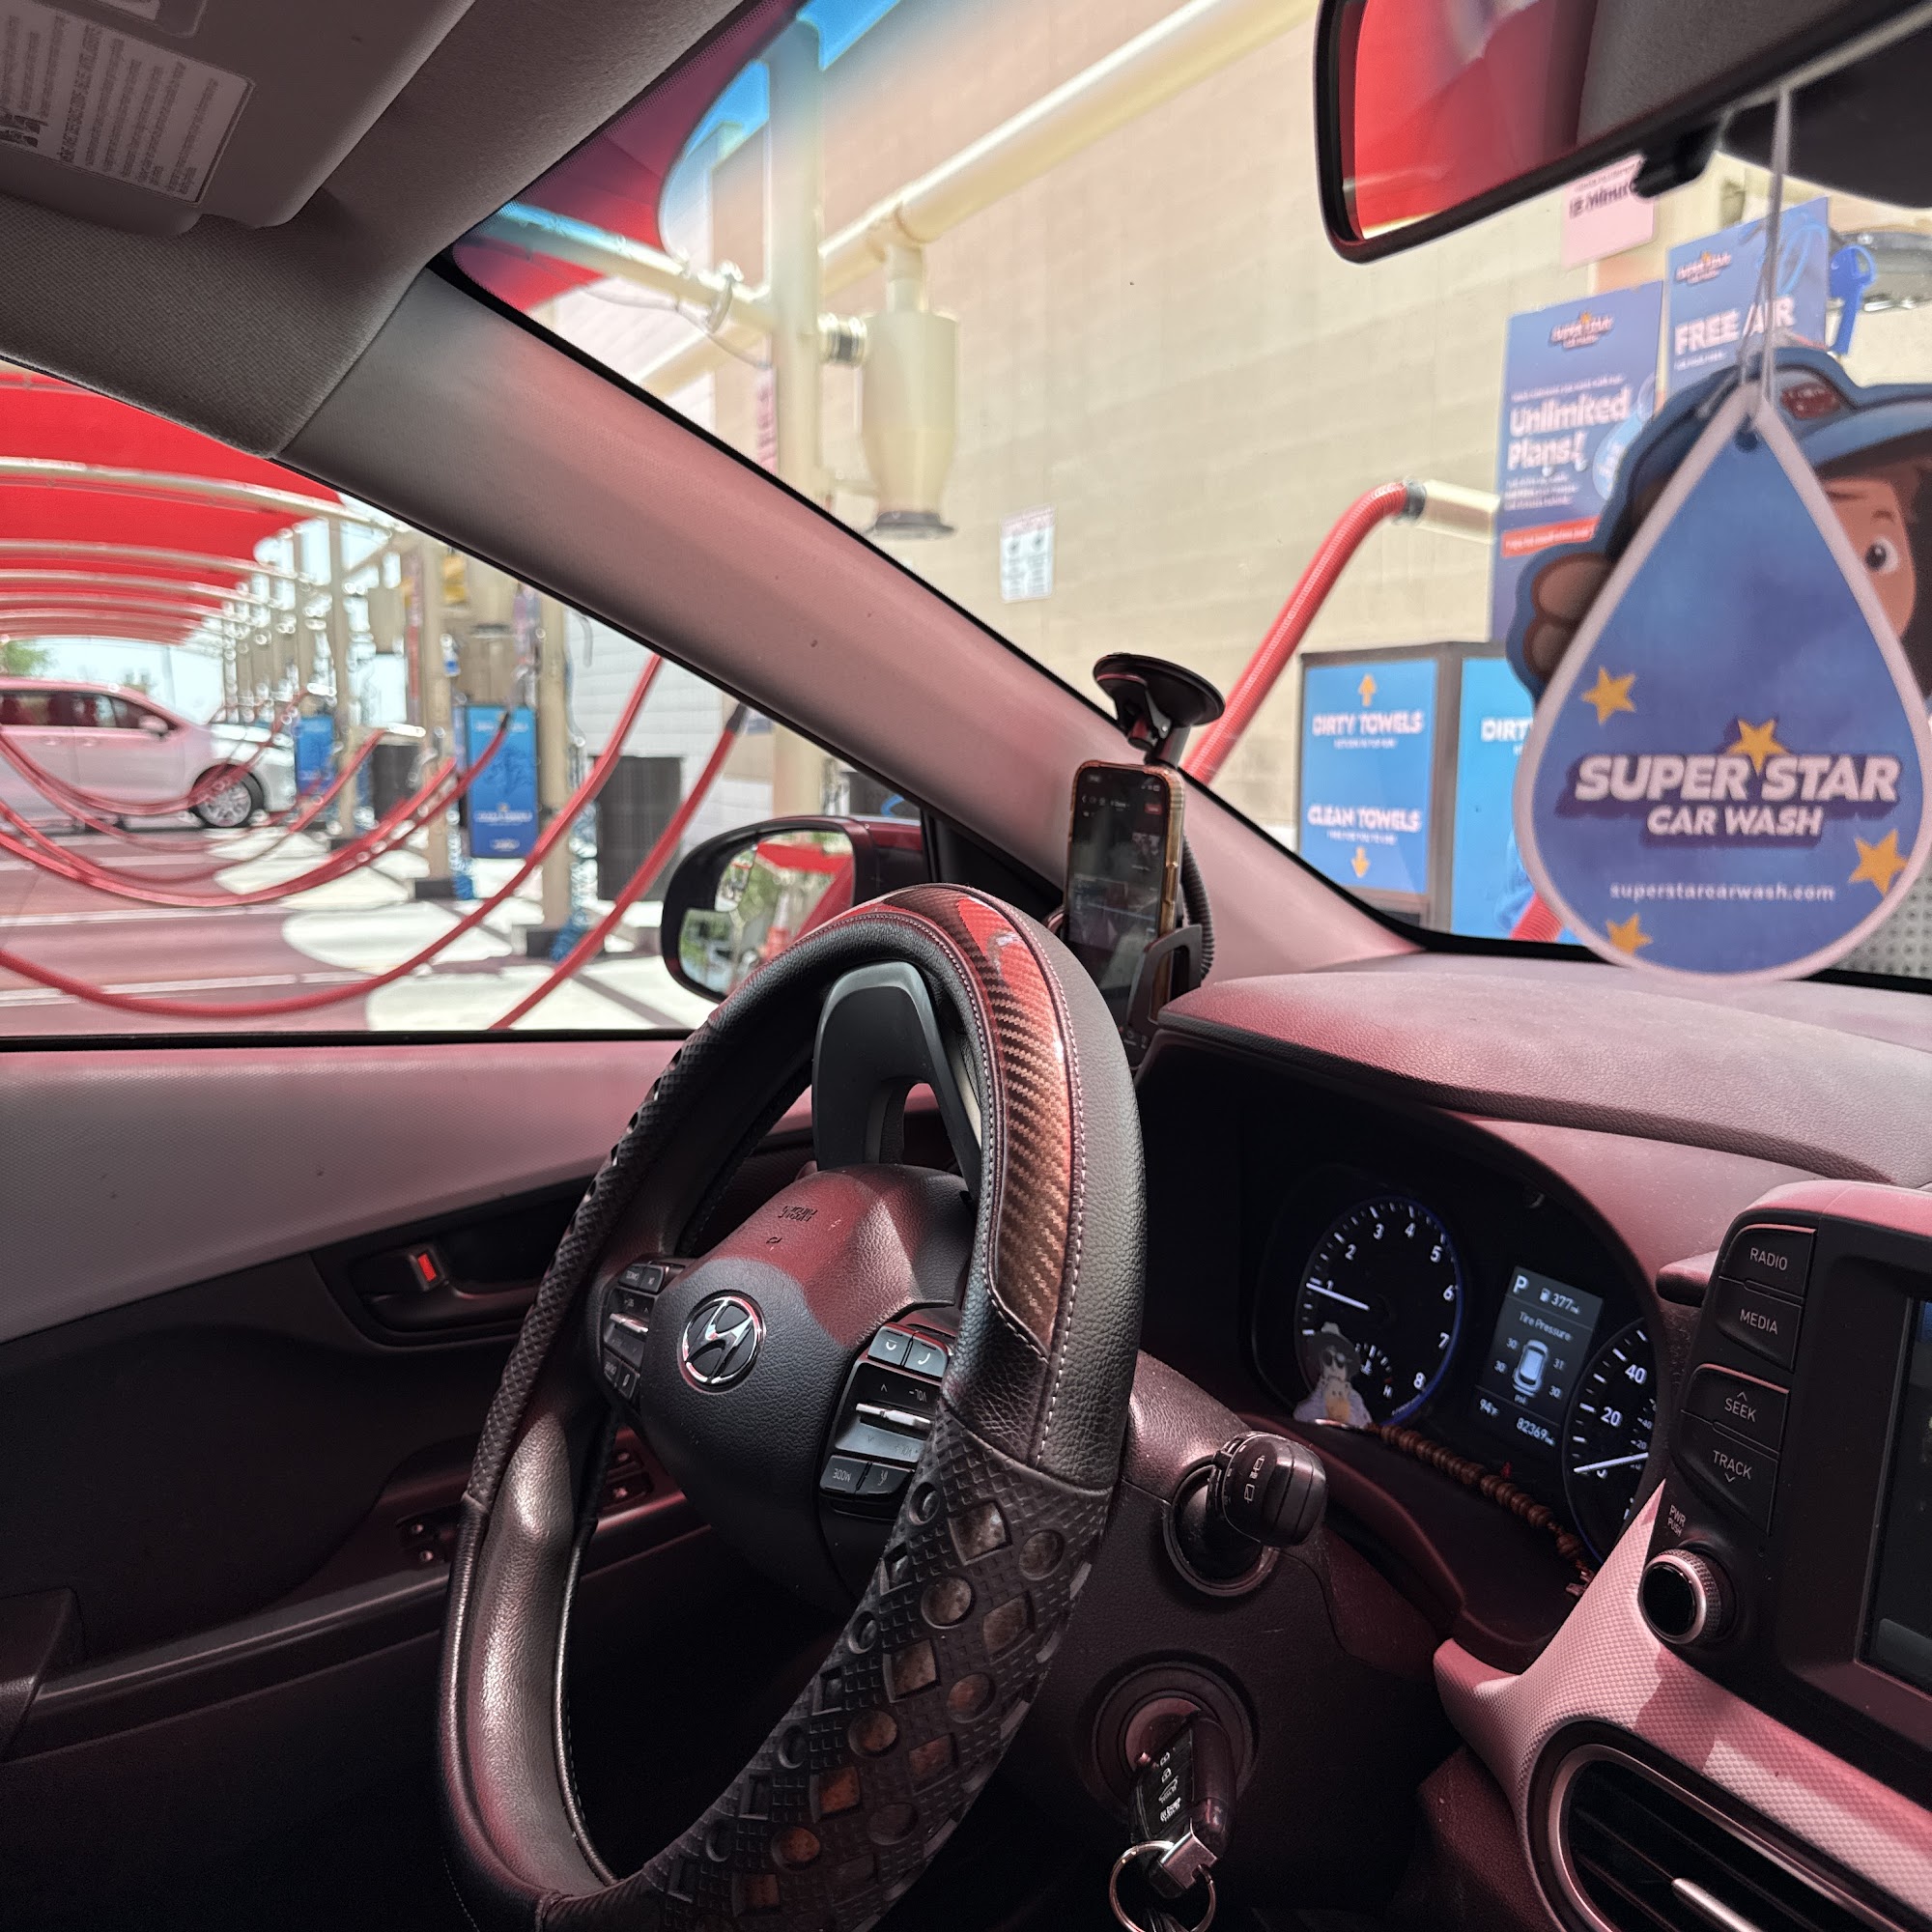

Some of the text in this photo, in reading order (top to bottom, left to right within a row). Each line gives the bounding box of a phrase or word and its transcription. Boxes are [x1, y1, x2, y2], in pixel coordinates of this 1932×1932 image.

[1675, 296, 1796, 355] FREE AIR
[1510, 386, 1633, 437] Unlimited
[1507, 431, 1587, 470] Plans!
[1312, 711, 1424, 736] DIRTY TOWELS
[1481, 717, 1533, 742] DIRT
[1575, 754, 1902, 803] SUPER STAR
[1307, 805, 1422, 833] CLEAN TOWELS
[1647, 806, 1824, 837] CAR WASH
[1610, 882, 1835, 902] superstarcarwash.com
[1373, 1224, 1384, 1240] 3
[1405, 1223, 1416, 1237] 4
[1346, 1244, 1357, 1261] 2
[1430, 1246, 1442, 1262] 5
[1749, 1247, 1789, 1272] RADIO
[1443, 1286, 1455, 1301] 6
[1513, 1274, 1529, 1294] P
[1520, 1311, 1573, 1342] Tire Pressure
[1739, 1307, 1779, 1336] MEDIA
[1437, 1332, 1450, 1349] 7
[1413, 1372, 1427, 1389] 8
[1625, 1363, 1648, 1385] 40
[1601, 1406, 1623, 1428] 20
[1724, 1397, 1757, 1423] SEEK
[832, 1467, 852, 1483] MODE
[1712, 1449, 1752, 1480] TRACK
[1667, 1517, 1684, 1537] PUSH
[1669, 1504, 1688, 1527] PWR
